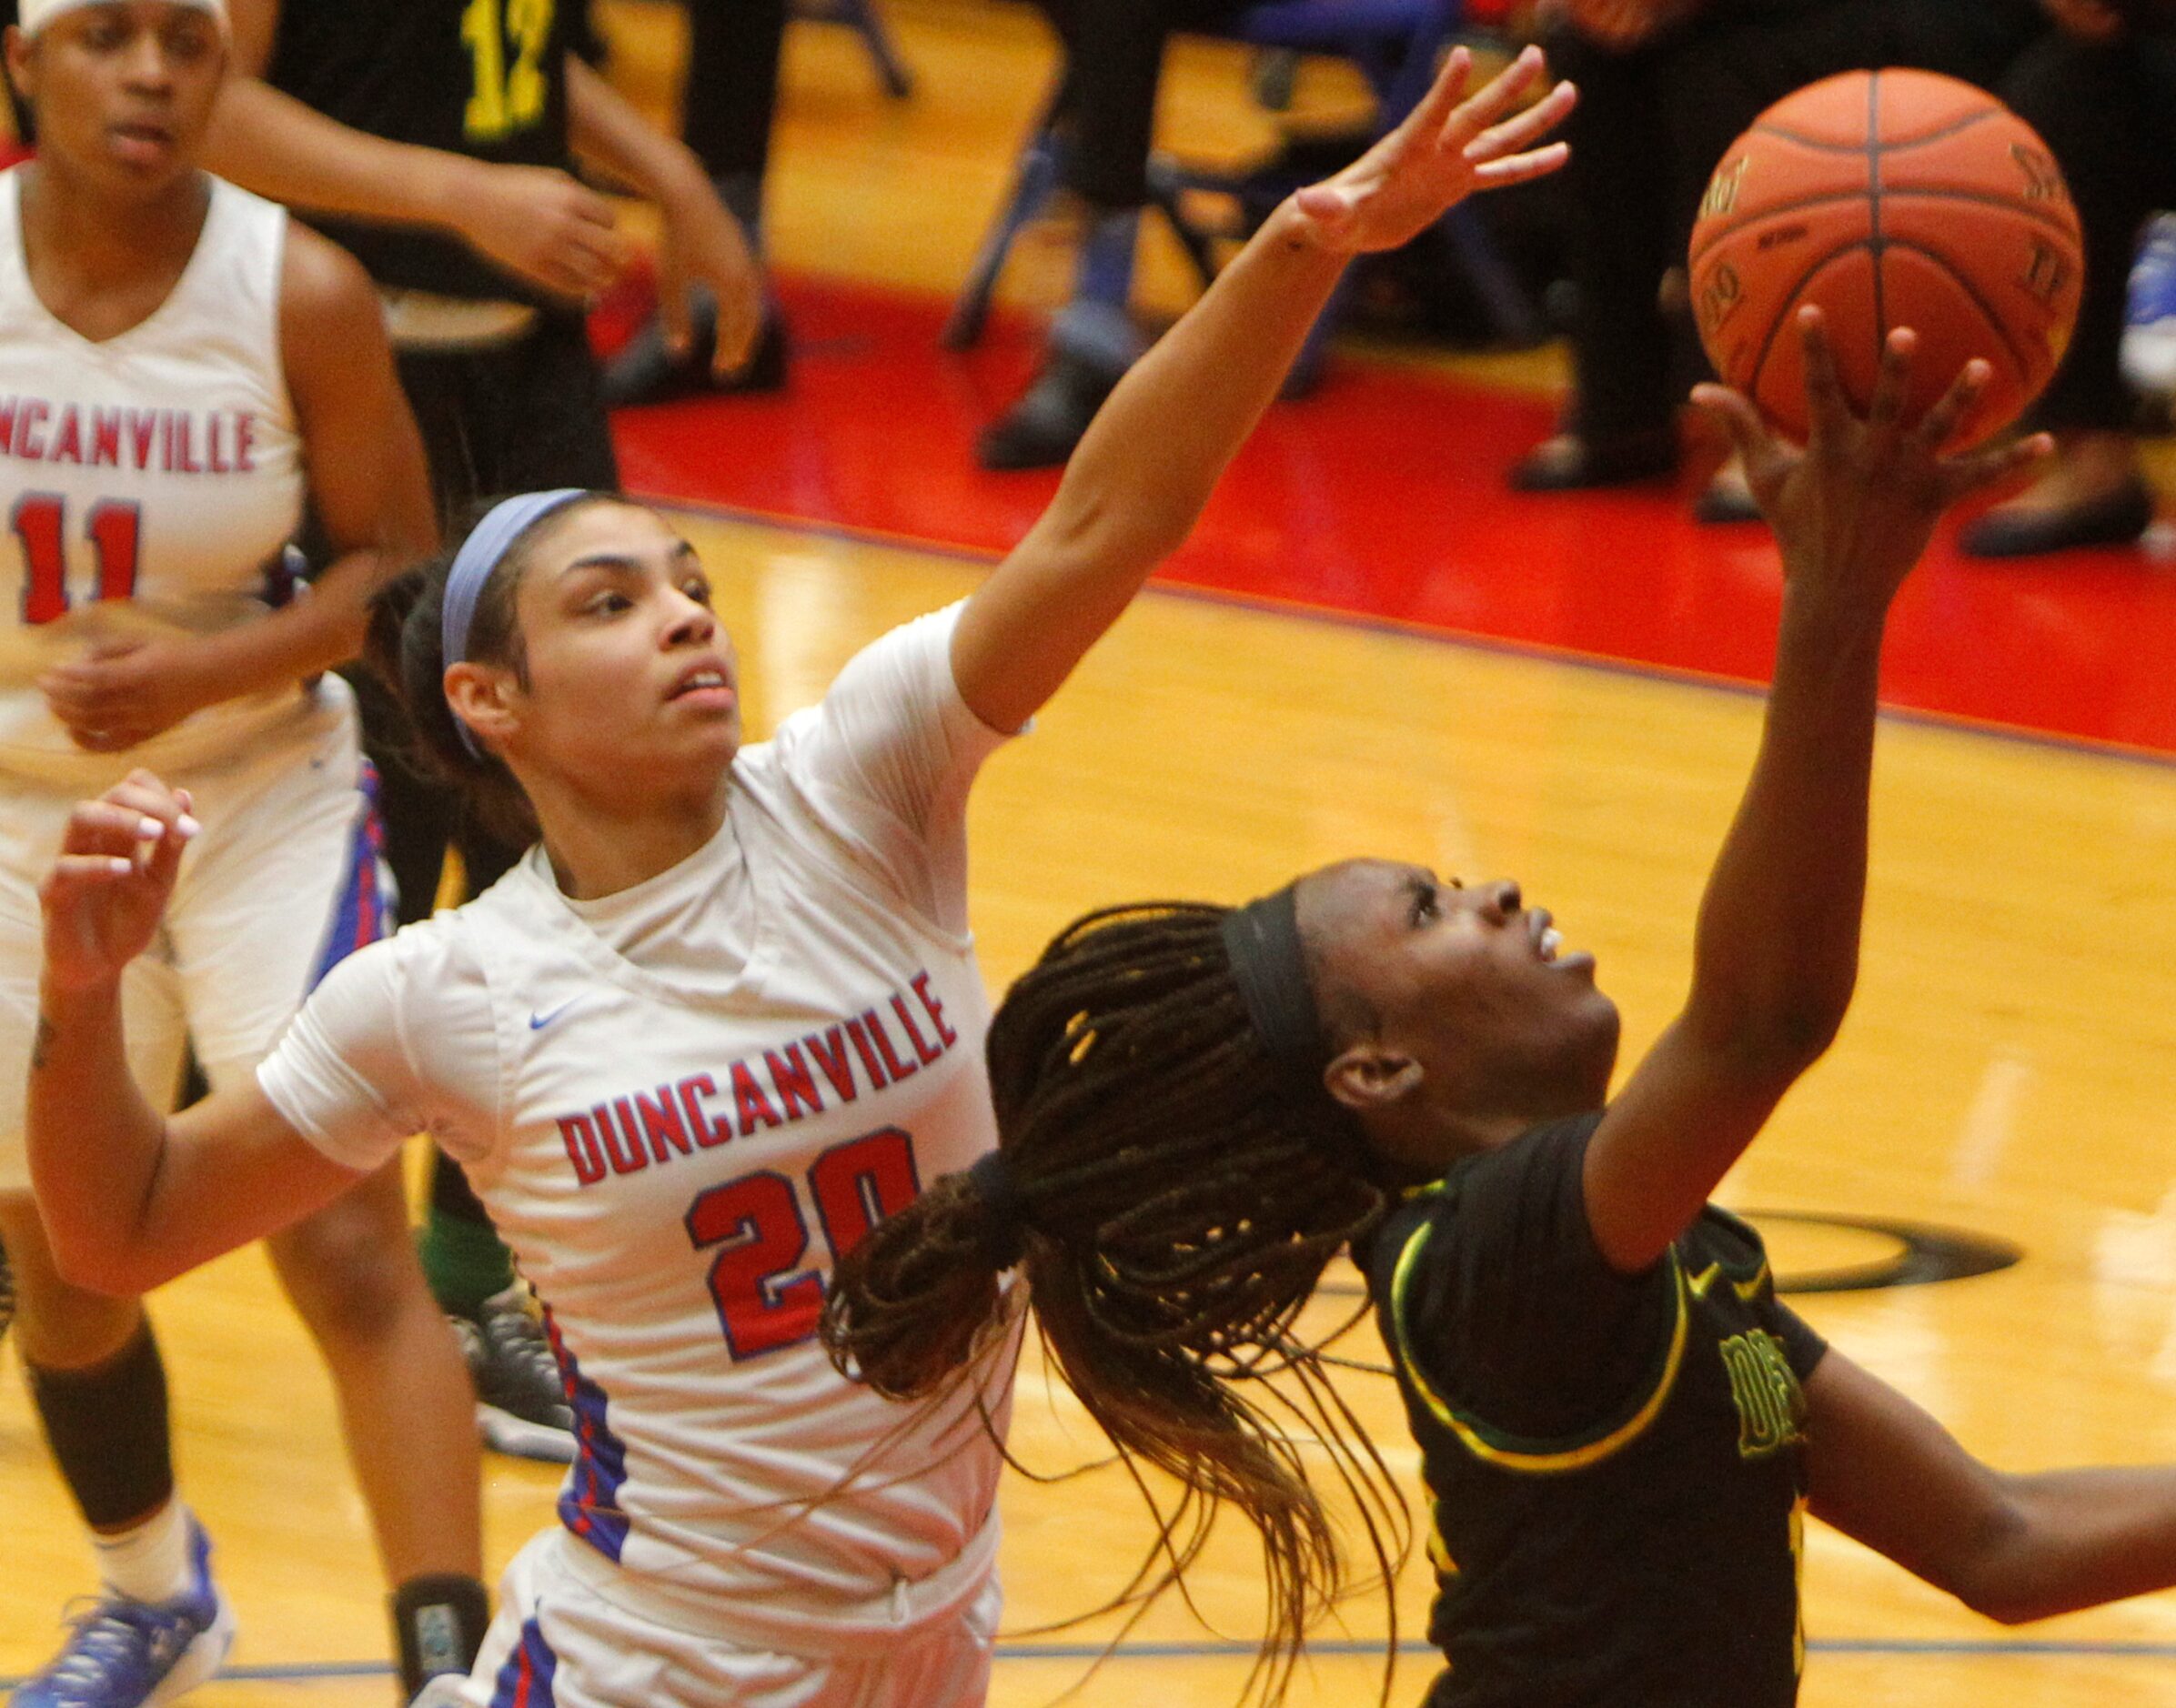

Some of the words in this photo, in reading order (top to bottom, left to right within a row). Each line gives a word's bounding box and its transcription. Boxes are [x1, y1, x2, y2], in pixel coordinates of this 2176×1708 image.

[459, 0, 554, 138] 12
[10, 490, 140, 625] 11
[556, 969, 957, 1187] DUNCANVILLE
[682, 1125, 921, 1363] 20
